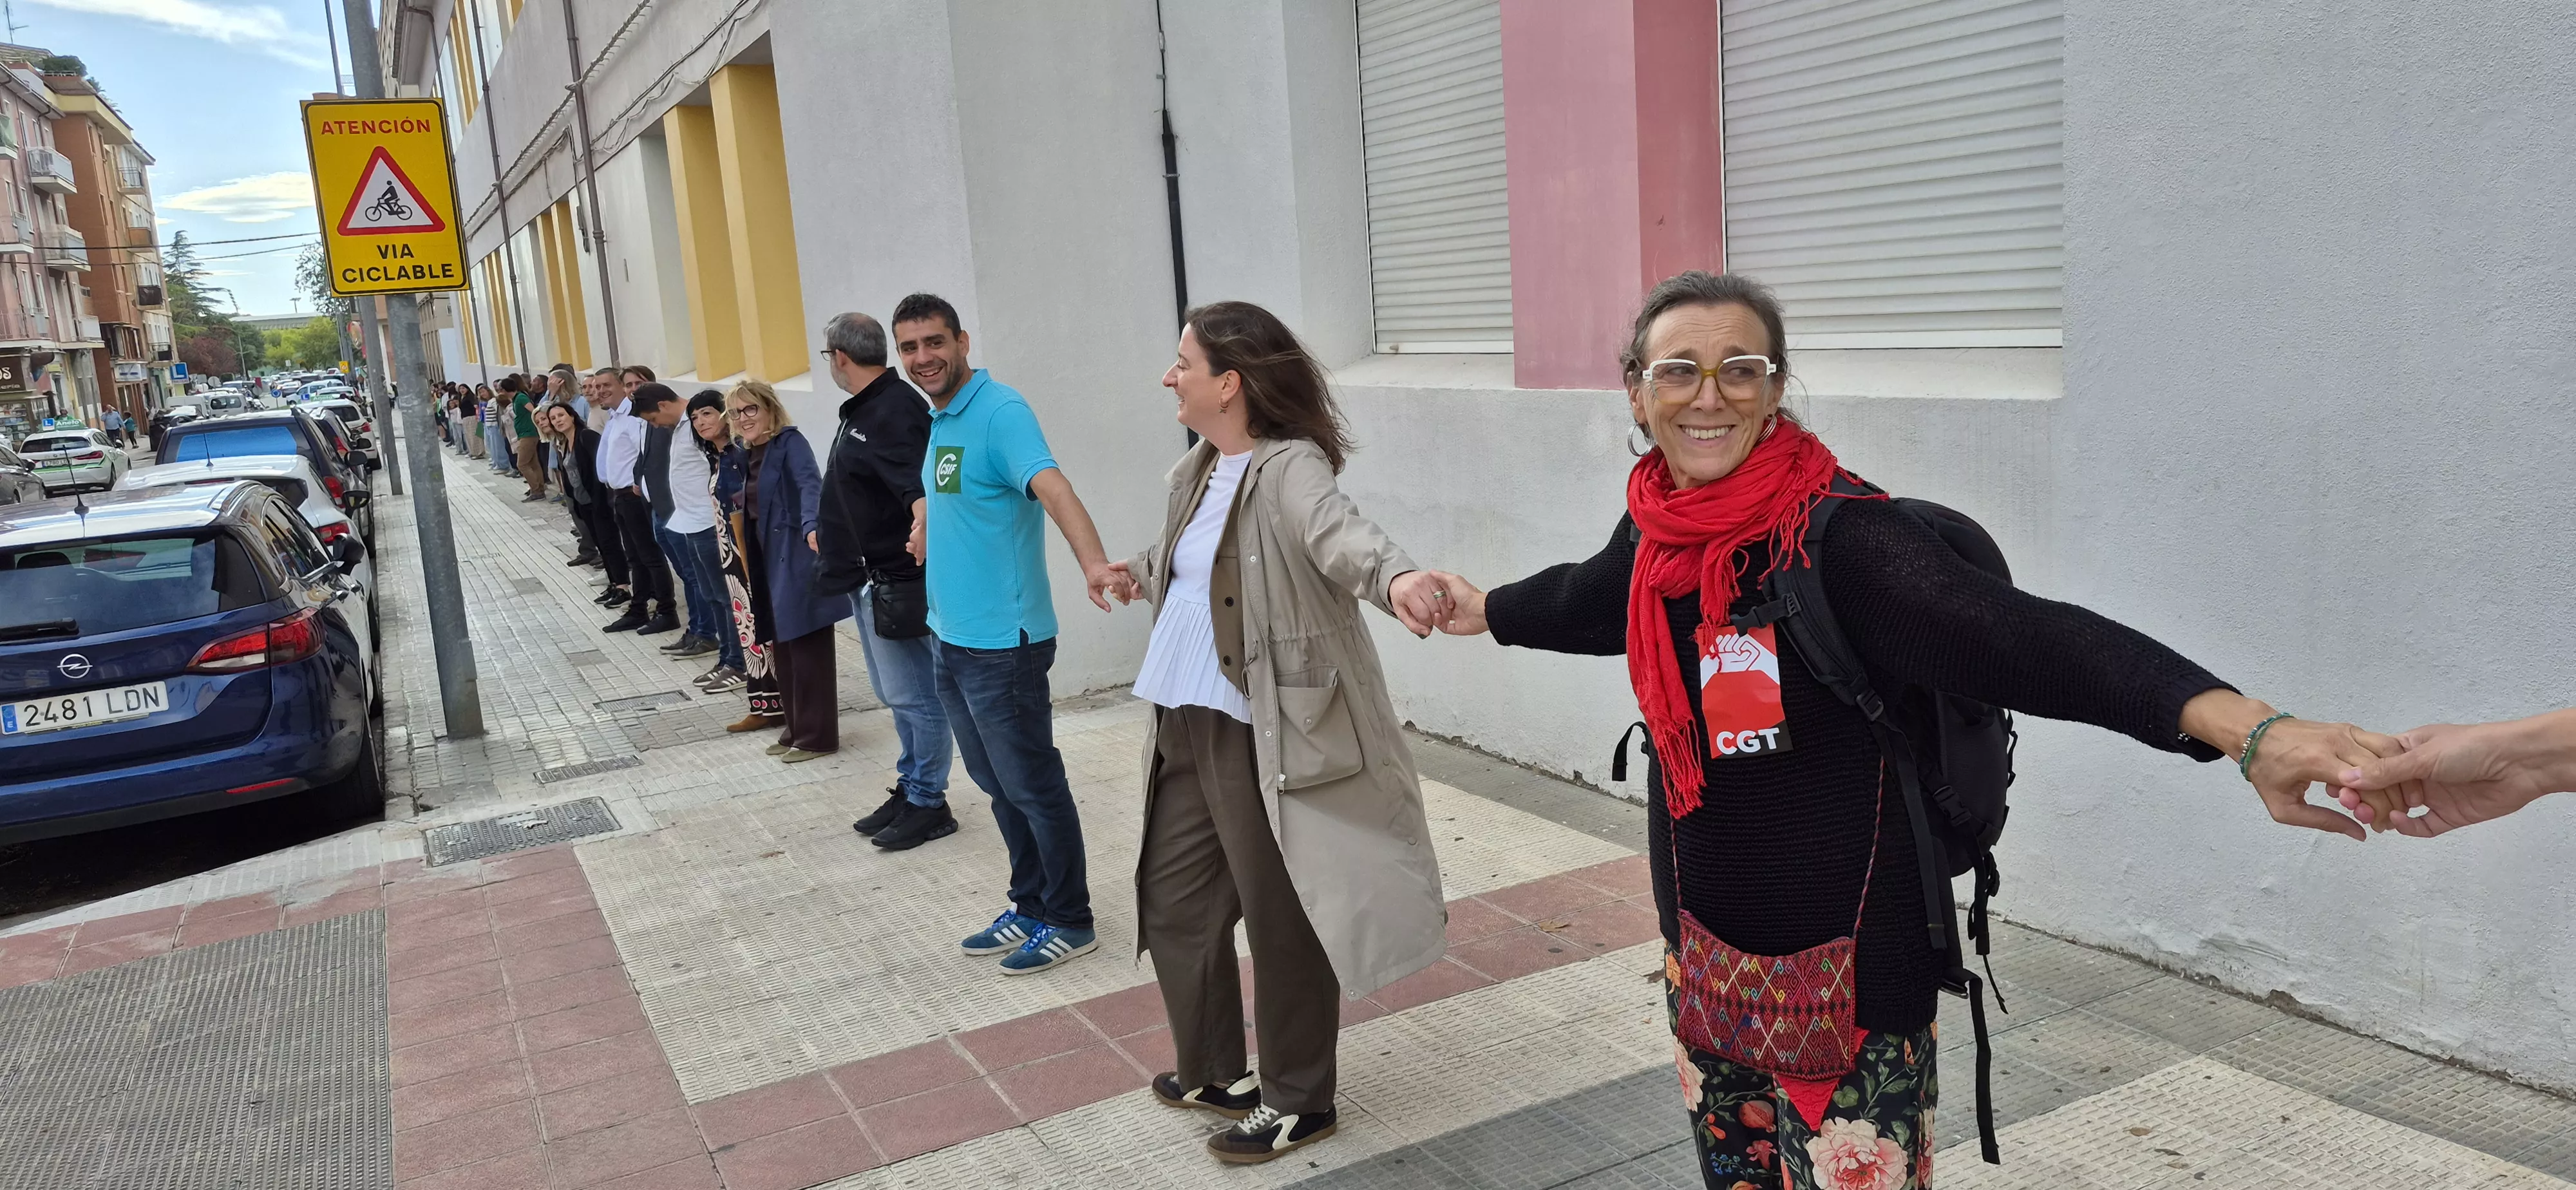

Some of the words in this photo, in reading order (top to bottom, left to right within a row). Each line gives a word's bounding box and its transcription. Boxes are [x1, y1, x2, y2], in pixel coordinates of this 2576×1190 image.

[321, 117, 431, 135] ATENCIÓN
[377, 243, 415, 260] VIA
[342, 263, 455, 283] CICLABLE
[24, 696, 93, 727] 2481
[106, 686, 160, 715] LDN
[1716, 727, 1780, 755] CGT
